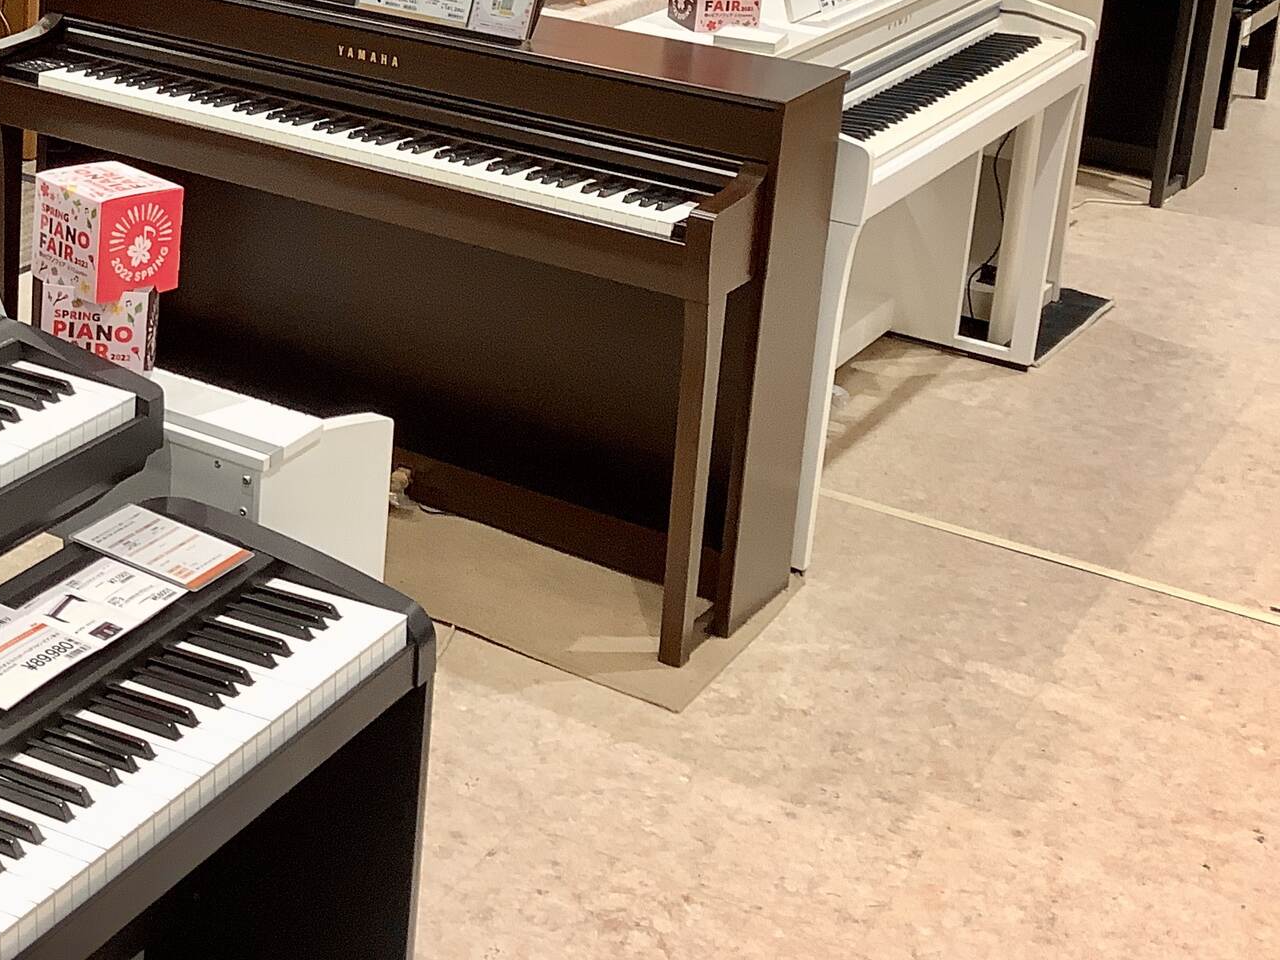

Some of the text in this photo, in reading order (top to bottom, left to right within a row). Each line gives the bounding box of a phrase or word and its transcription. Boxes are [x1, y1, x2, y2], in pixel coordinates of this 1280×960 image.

[704, 0, 740, 12] FAIR
[338, 45, 399, 68] YAMAHA
[41, 202, 69, 223] SPRING
[40, 213, 90, 249] PIANO
[39, 231, 74, 261] FAIR
[111, 246, 169, 282] 2022 SPRING
[54, 308, 101, 322] SPRING
[52, 320, 133, 343] PIANO
[21, 641, 74, 671] ¥89,980
